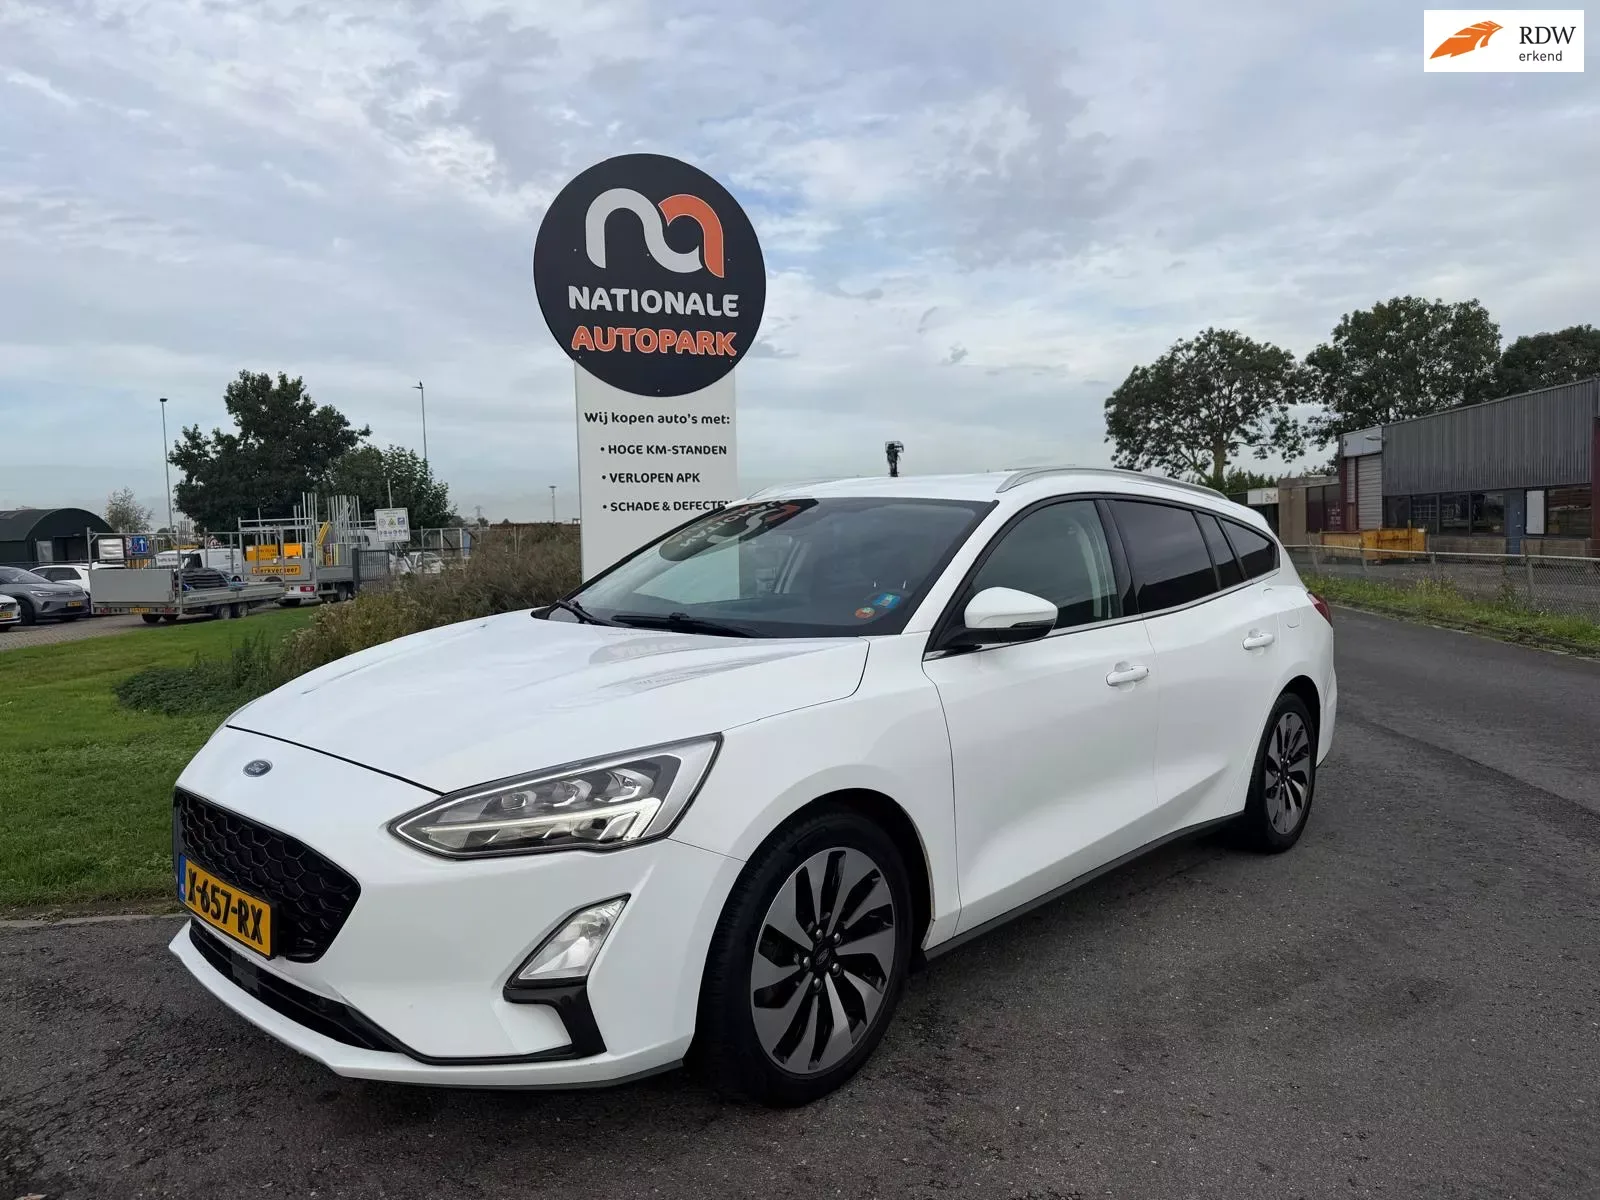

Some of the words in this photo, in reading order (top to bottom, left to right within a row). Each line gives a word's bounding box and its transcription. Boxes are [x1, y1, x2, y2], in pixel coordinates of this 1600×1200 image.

[568, 285, 740, 318] NATIONALE
[571, 325, 738, 357] AUTOPARK
[584, 411, 608, 425] Wij
[611, 412, 654, 425] kopen
[657, 413, 698, 425] auto's
[701, 414, 731, 425] met:
[608, 444, 644, 455] HOGE
[646, 445, 727, 455] KM-STANDEN
[609, 472, 674, 484] VERLOPEN
[676, 472, 701, 483] APK
[610, 501, 660, 512] SCHADE
[662, 501, 671, 511] &
[187, 867, 264, 946] X-657-RX
